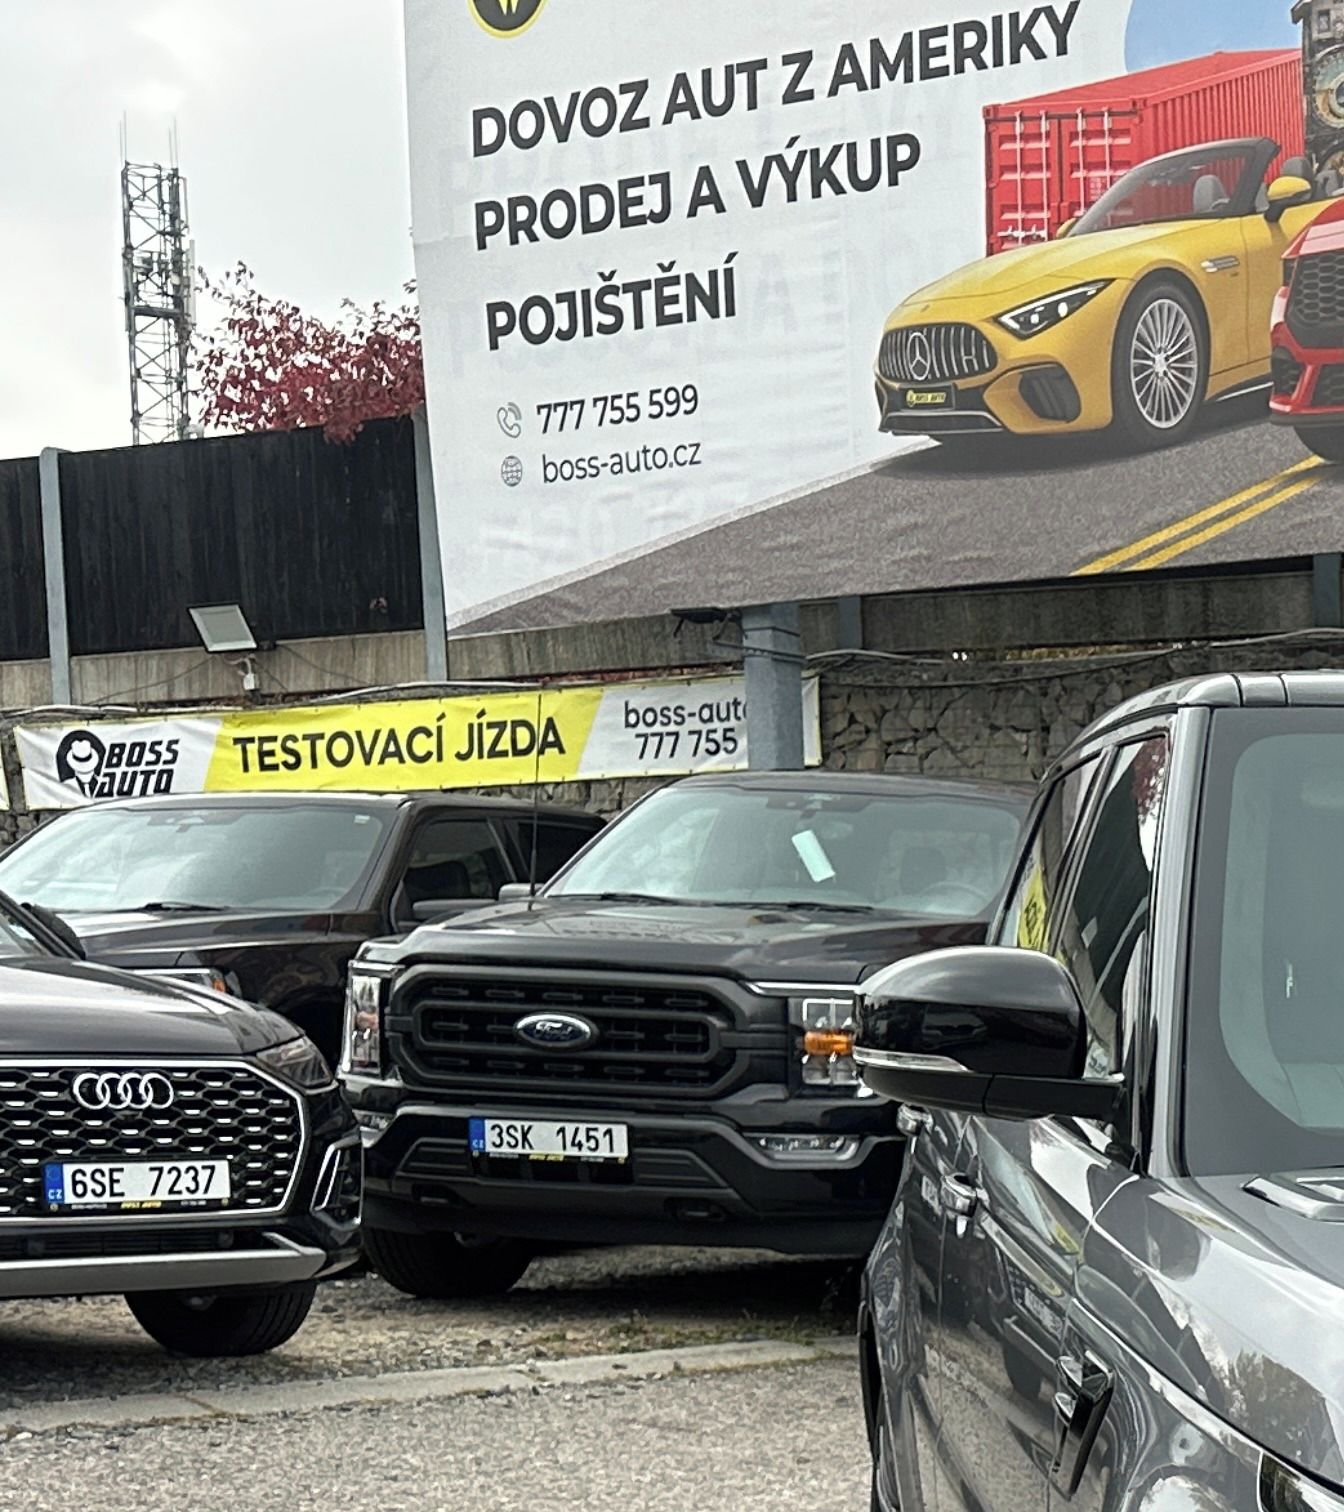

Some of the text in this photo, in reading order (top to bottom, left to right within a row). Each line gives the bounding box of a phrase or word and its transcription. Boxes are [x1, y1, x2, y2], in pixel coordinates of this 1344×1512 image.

[473, 0, 1082, 157] DOVOZ AUT Z AMERIKY
[474, 133, 921, 251] PRODEJ A VÝKUP
[485, 251, 739, 351] POJIŠTĚNÍ
[536, 384, 699, 434] 777 755 599
[542, 443, 702, 484] boss-auto.cz
[624, 697, 748, 729] boss-aut
[105, 738, 180, 769] BOSS
[232, 708, 567, 774] TESTOVACÍ JÍZDA
[635, 728, 738, 760] 777 755
[94, 768, 174, 798] AUTO
[490, 1124, 614, 1153] 3SK 1451
[48, 1188, 63, 1200] CZ
[71, 1165, 216, 1198] 6SE 7237
